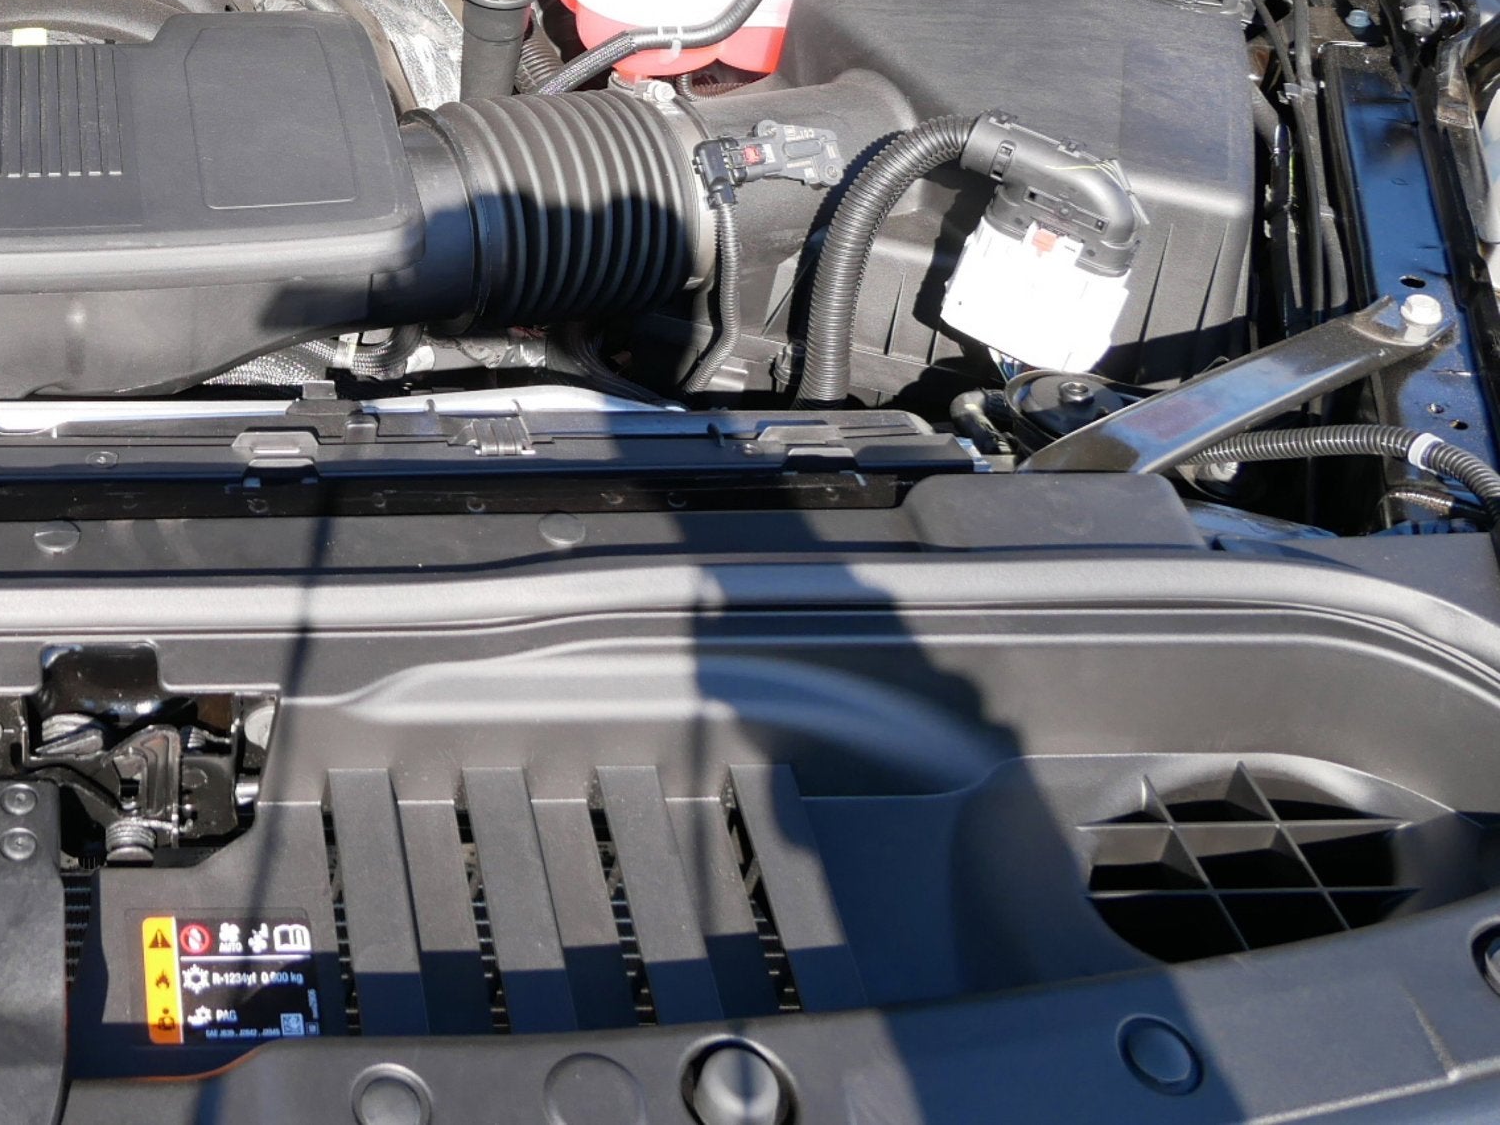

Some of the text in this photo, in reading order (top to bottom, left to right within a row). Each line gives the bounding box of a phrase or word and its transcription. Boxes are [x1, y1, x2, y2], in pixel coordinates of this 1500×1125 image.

[219, 941, 243, 953] AUTO
[290, 971, 304, 985] kg
[216, 1009, 238, 1022] PAG
